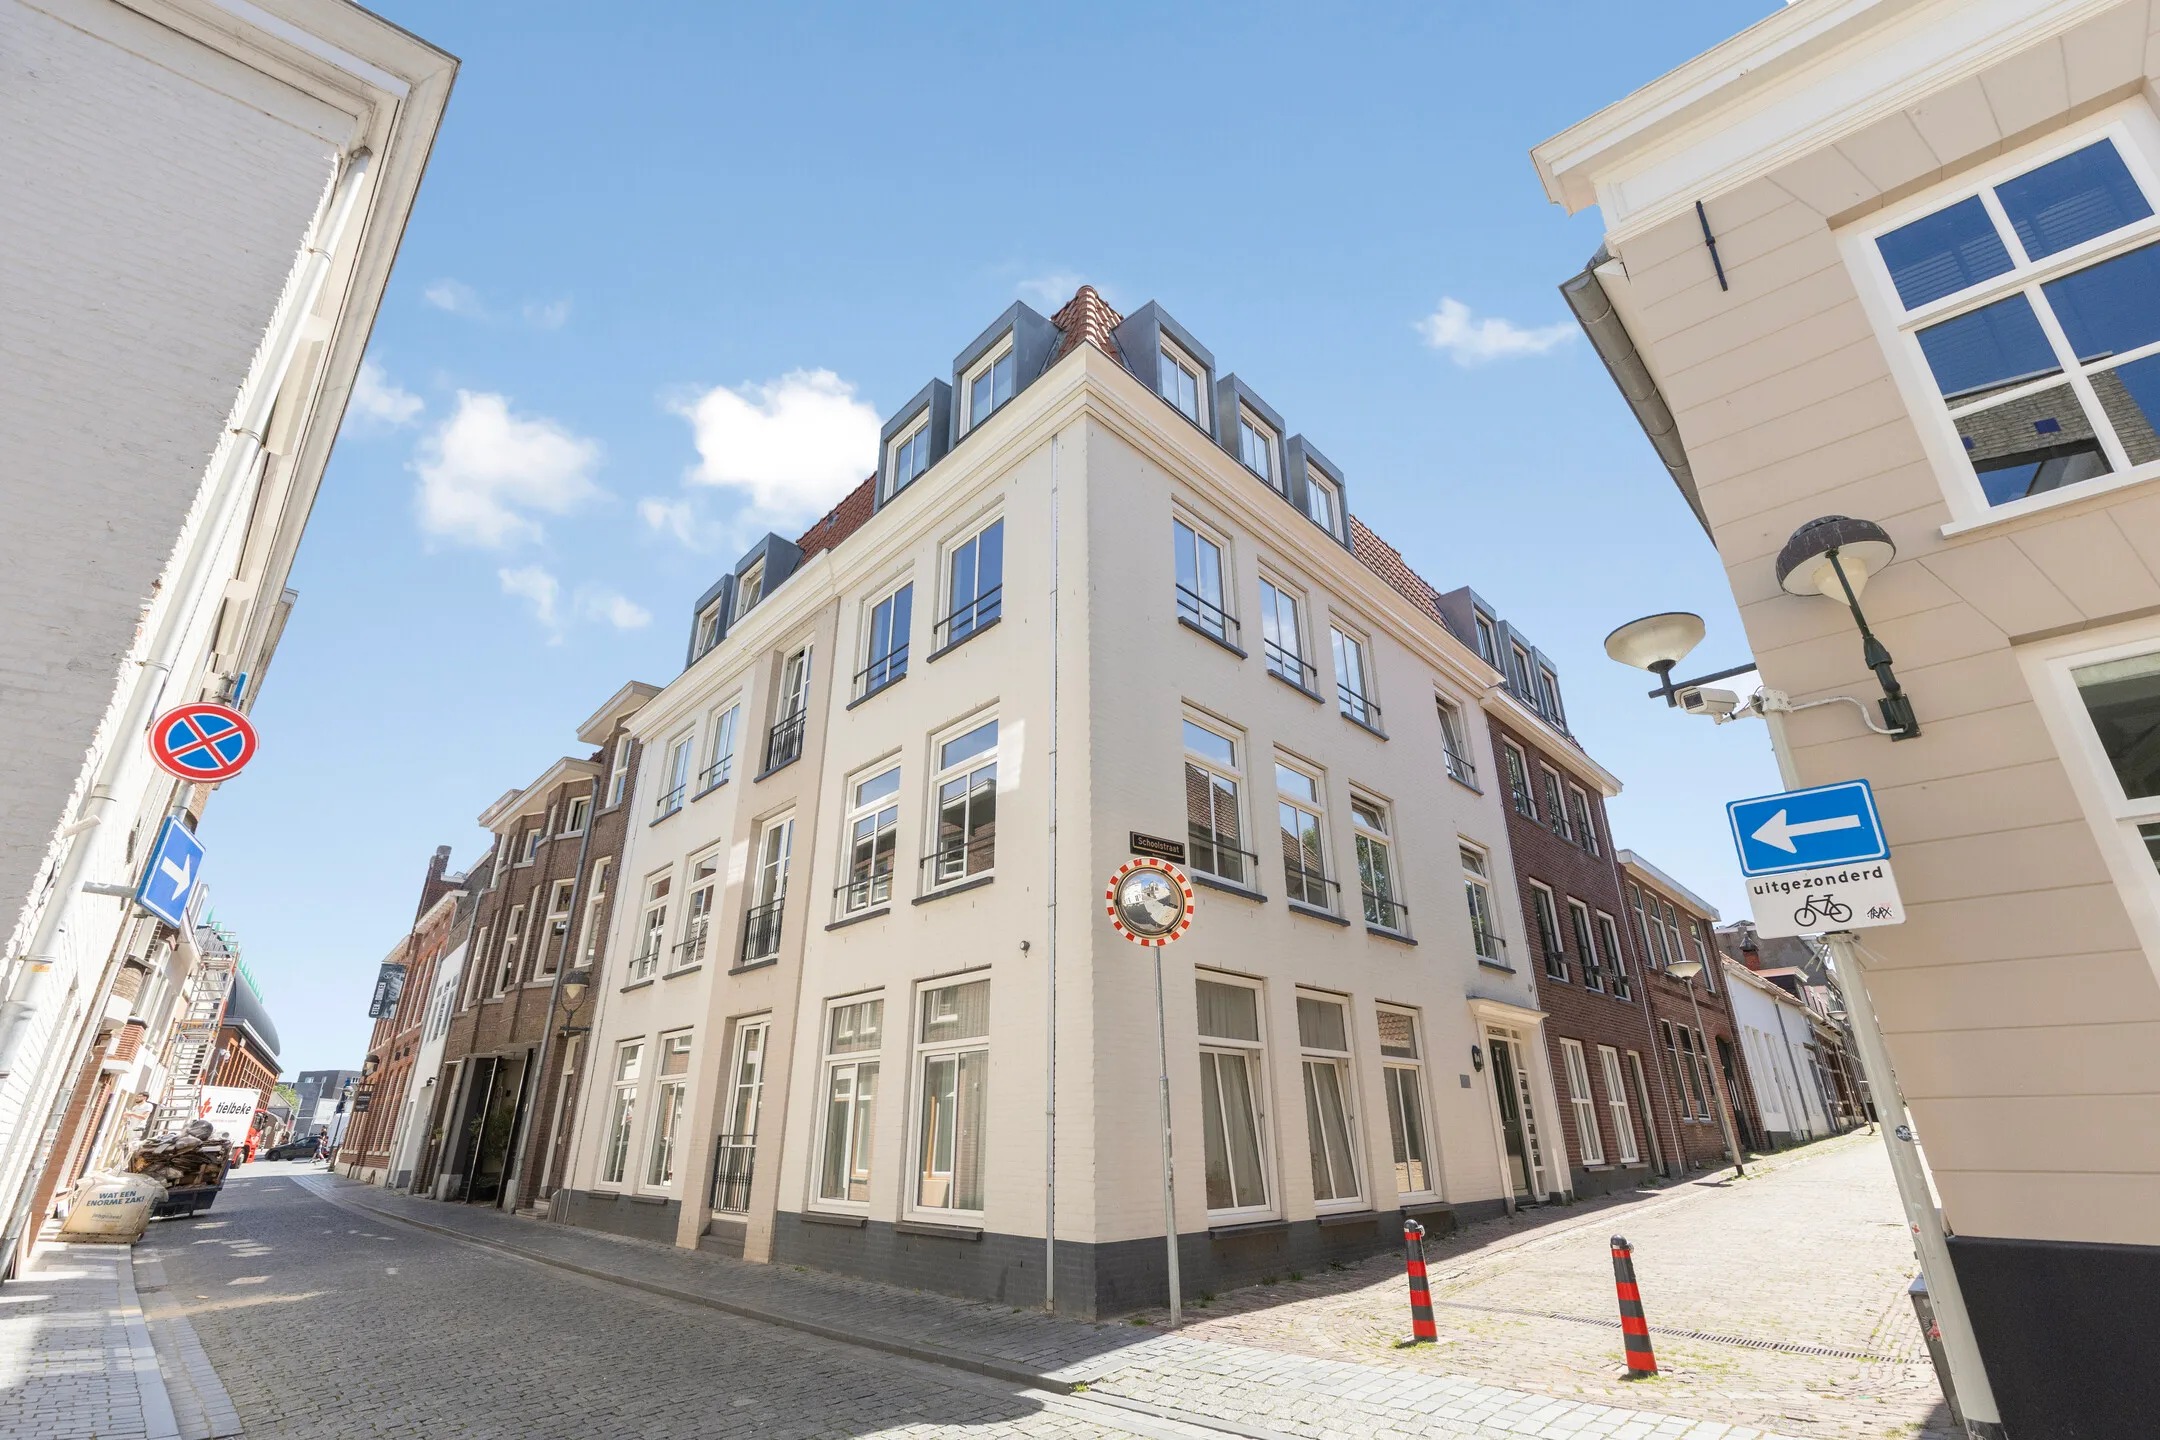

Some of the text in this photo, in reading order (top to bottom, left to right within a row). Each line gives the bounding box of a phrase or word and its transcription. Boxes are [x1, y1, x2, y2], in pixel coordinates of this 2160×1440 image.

[1137, 836, 1180, 853] Schoolstraat
[1753, 865, 1883, 894] uitgezonderd
[215, 1101, 252, 1115] tielbeke
[125, 1196, 145, 1204] ZAK!
